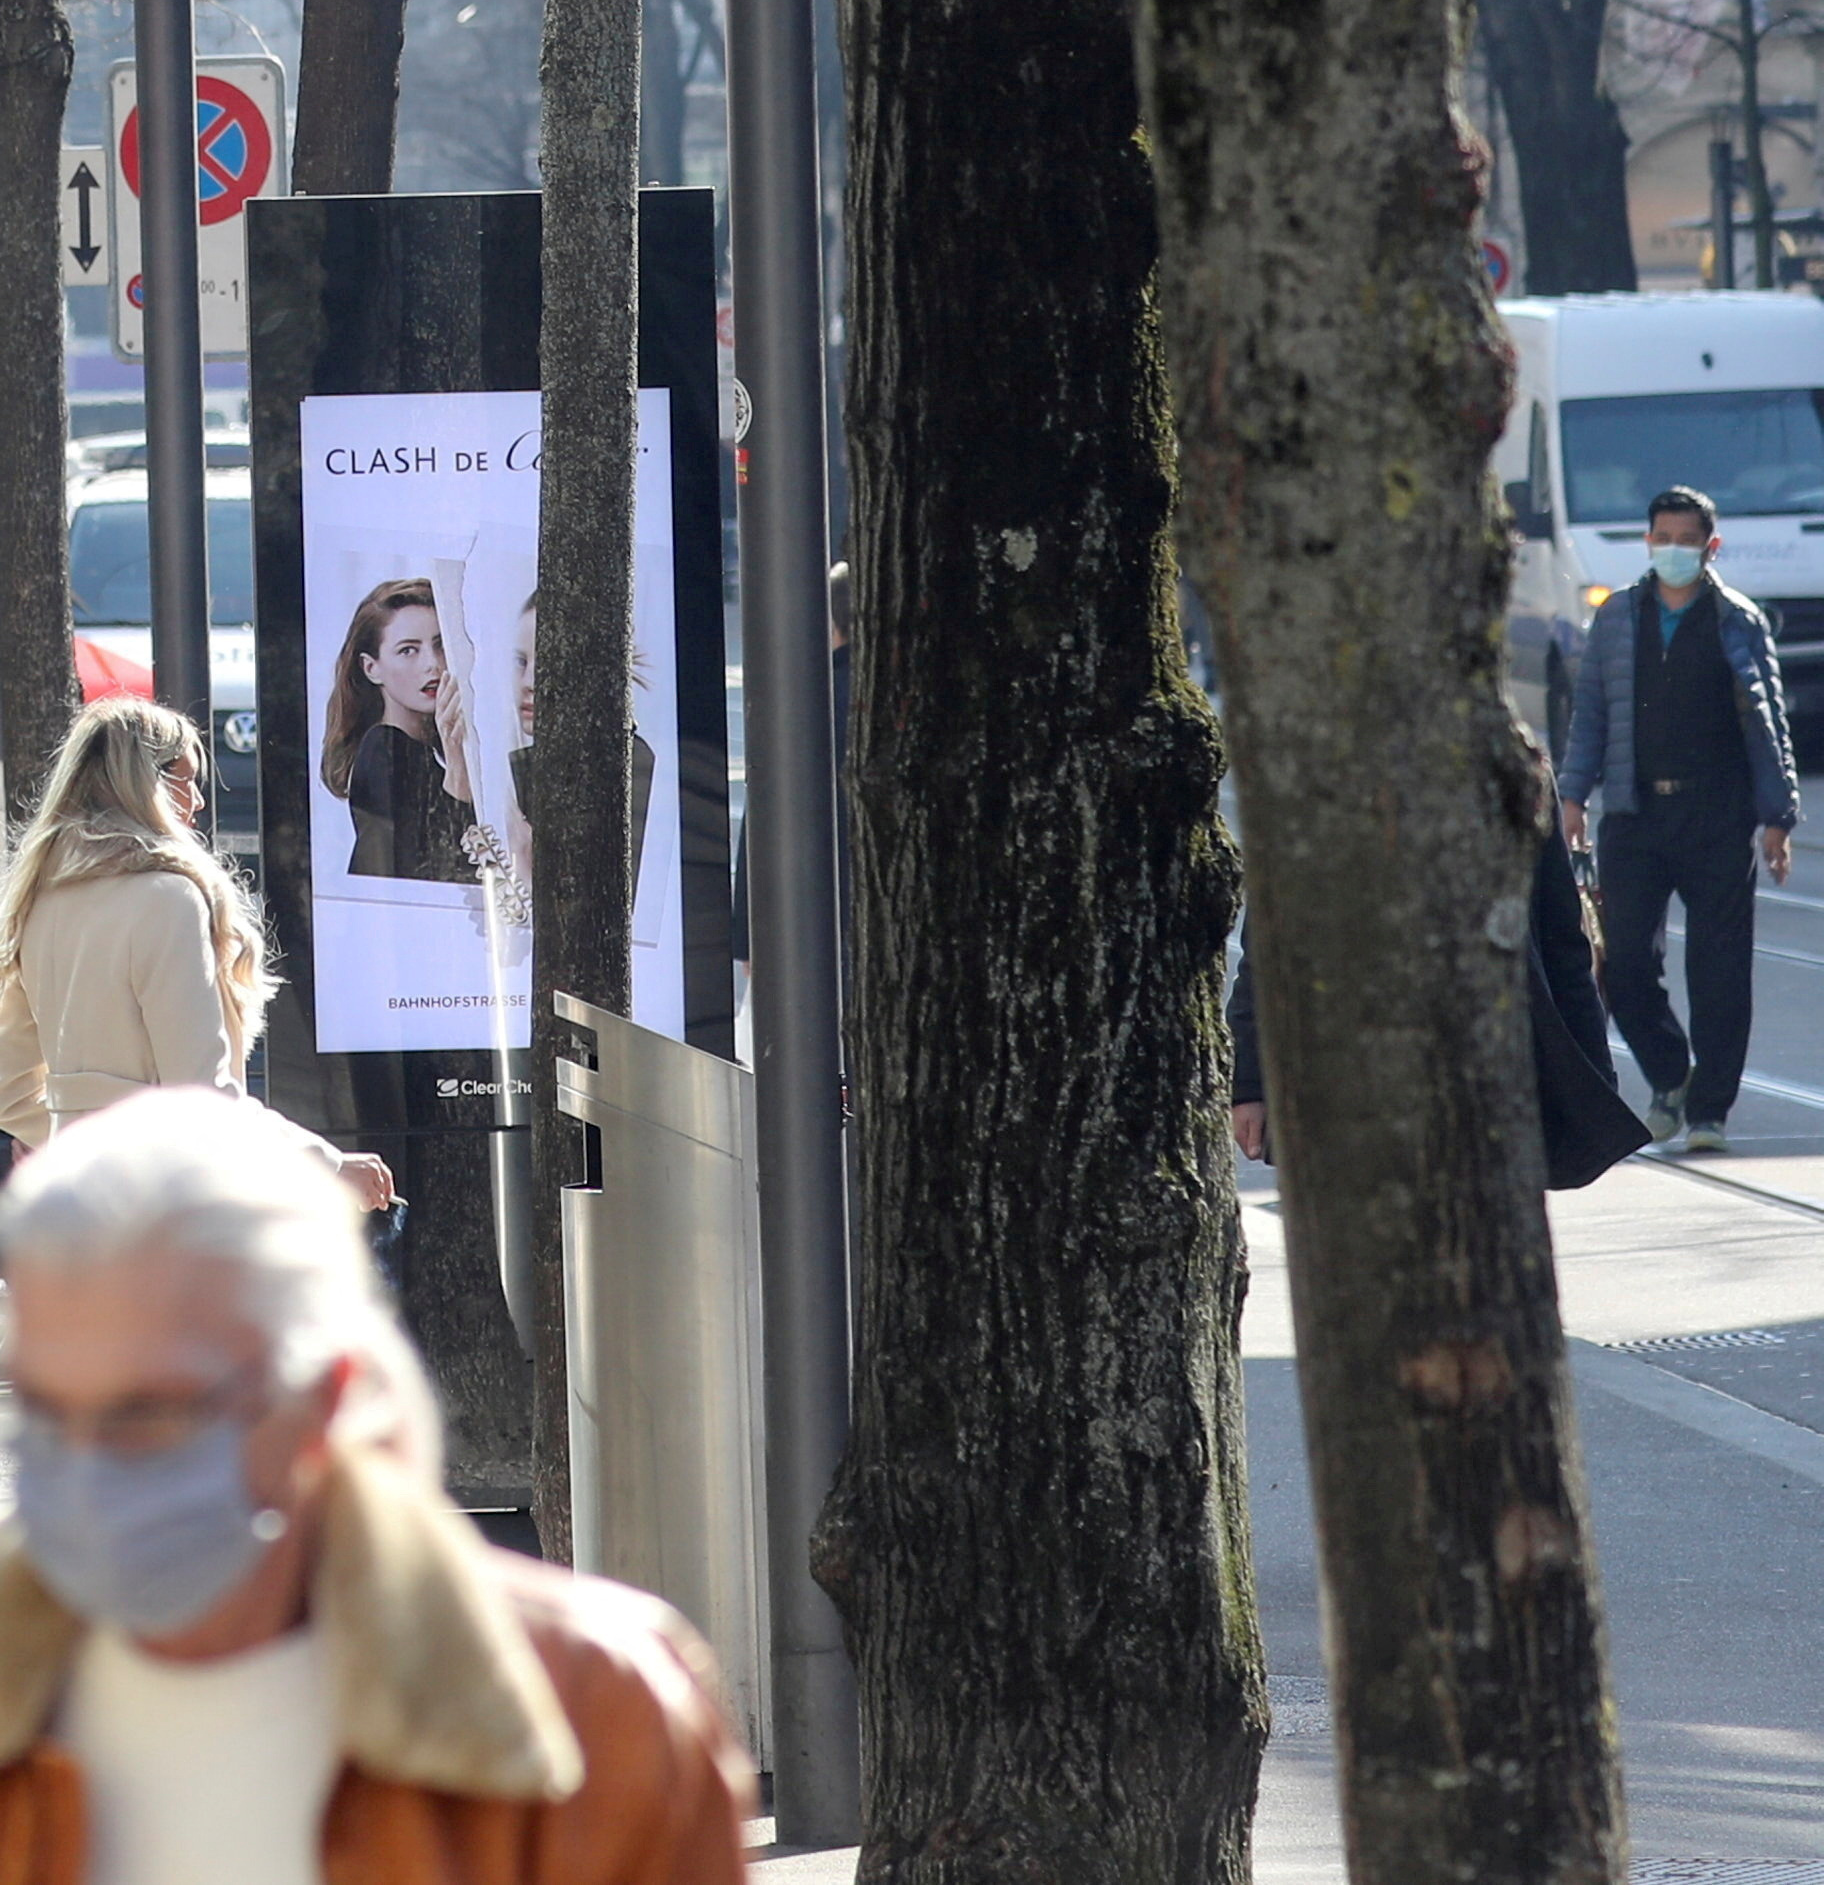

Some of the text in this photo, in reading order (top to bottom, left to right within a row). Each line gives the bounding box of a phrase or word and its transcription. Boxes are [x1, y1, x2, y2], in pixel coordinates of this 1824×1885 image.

[325, 447, 489, 475] CLASH DE
[388, 995, 527, 1010] BAHNHOFSTRASSE
[461, 1079, 502, 1095] Clear
